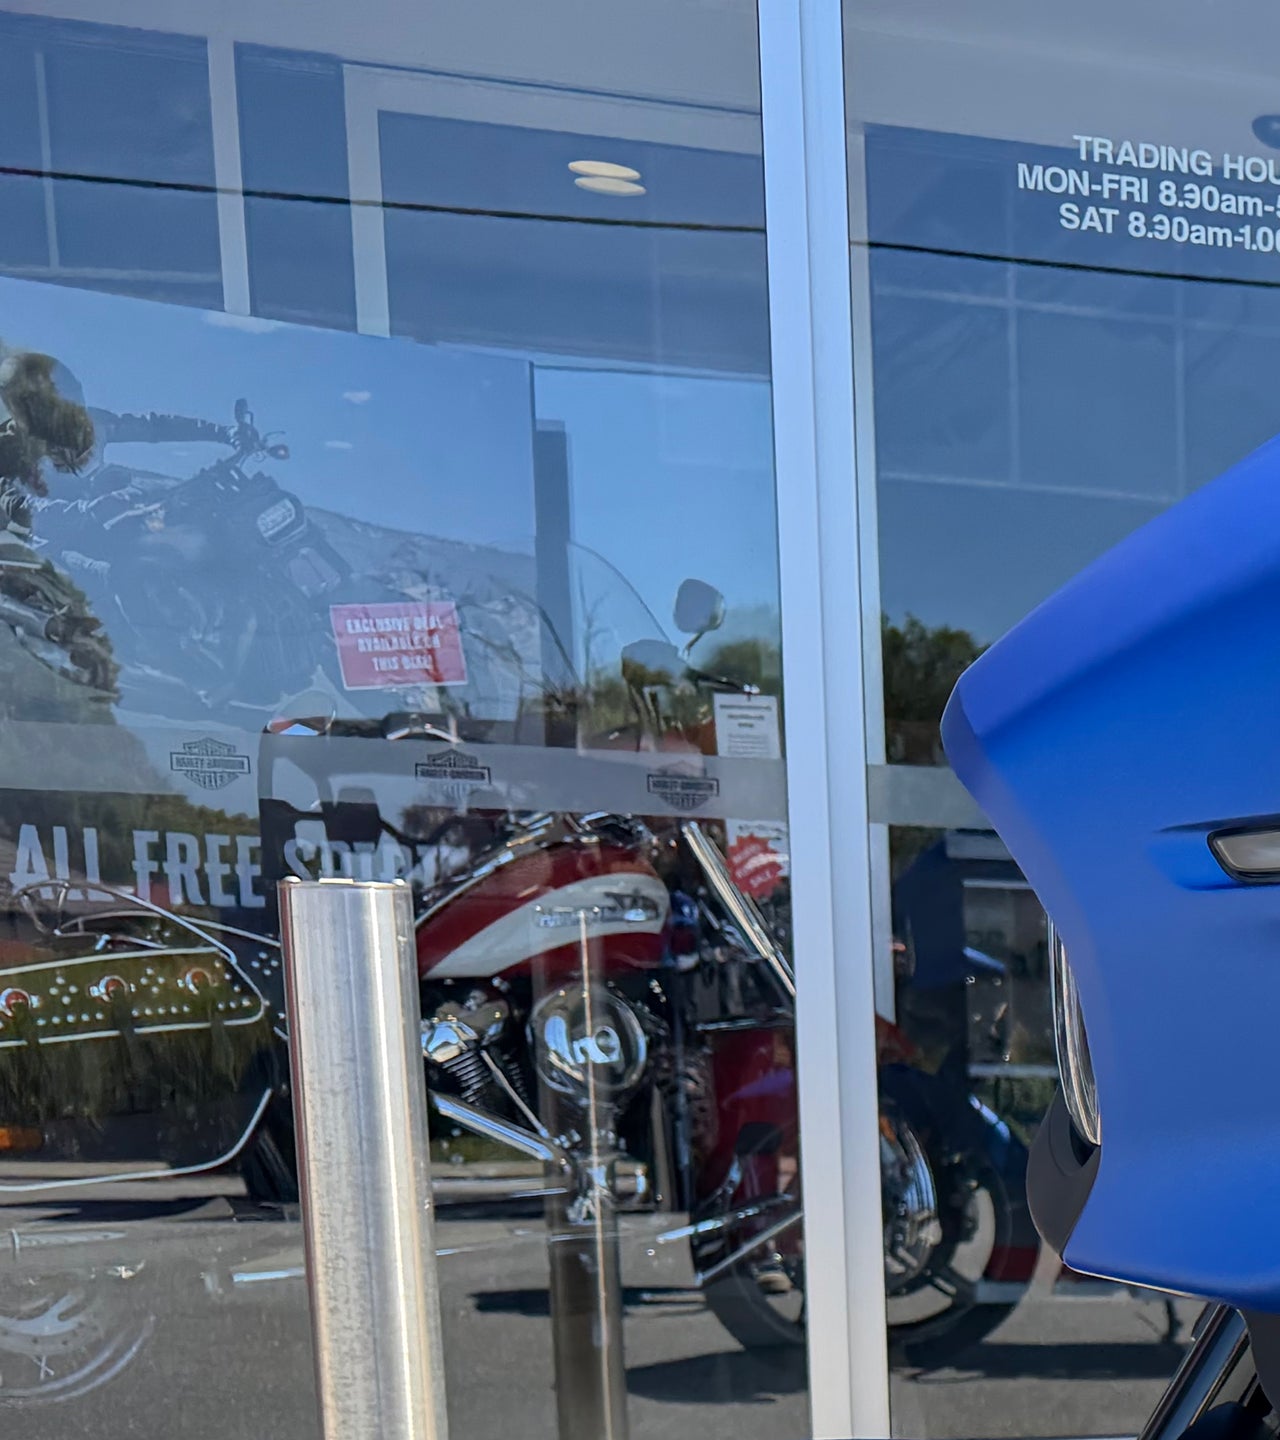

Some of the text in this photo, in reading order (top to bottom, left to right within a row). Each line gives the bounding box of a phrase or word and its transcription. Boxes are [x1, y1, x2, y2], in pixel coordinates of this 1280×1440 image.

[1073, 135, 1213, 177] TRADING
[1017, 163, 1149, 204] MON-FRI
[1059, 203, 1119, 234] SAT
[9, 824, 115, 901] ALL
[132, 830, 266, 908] FREE
